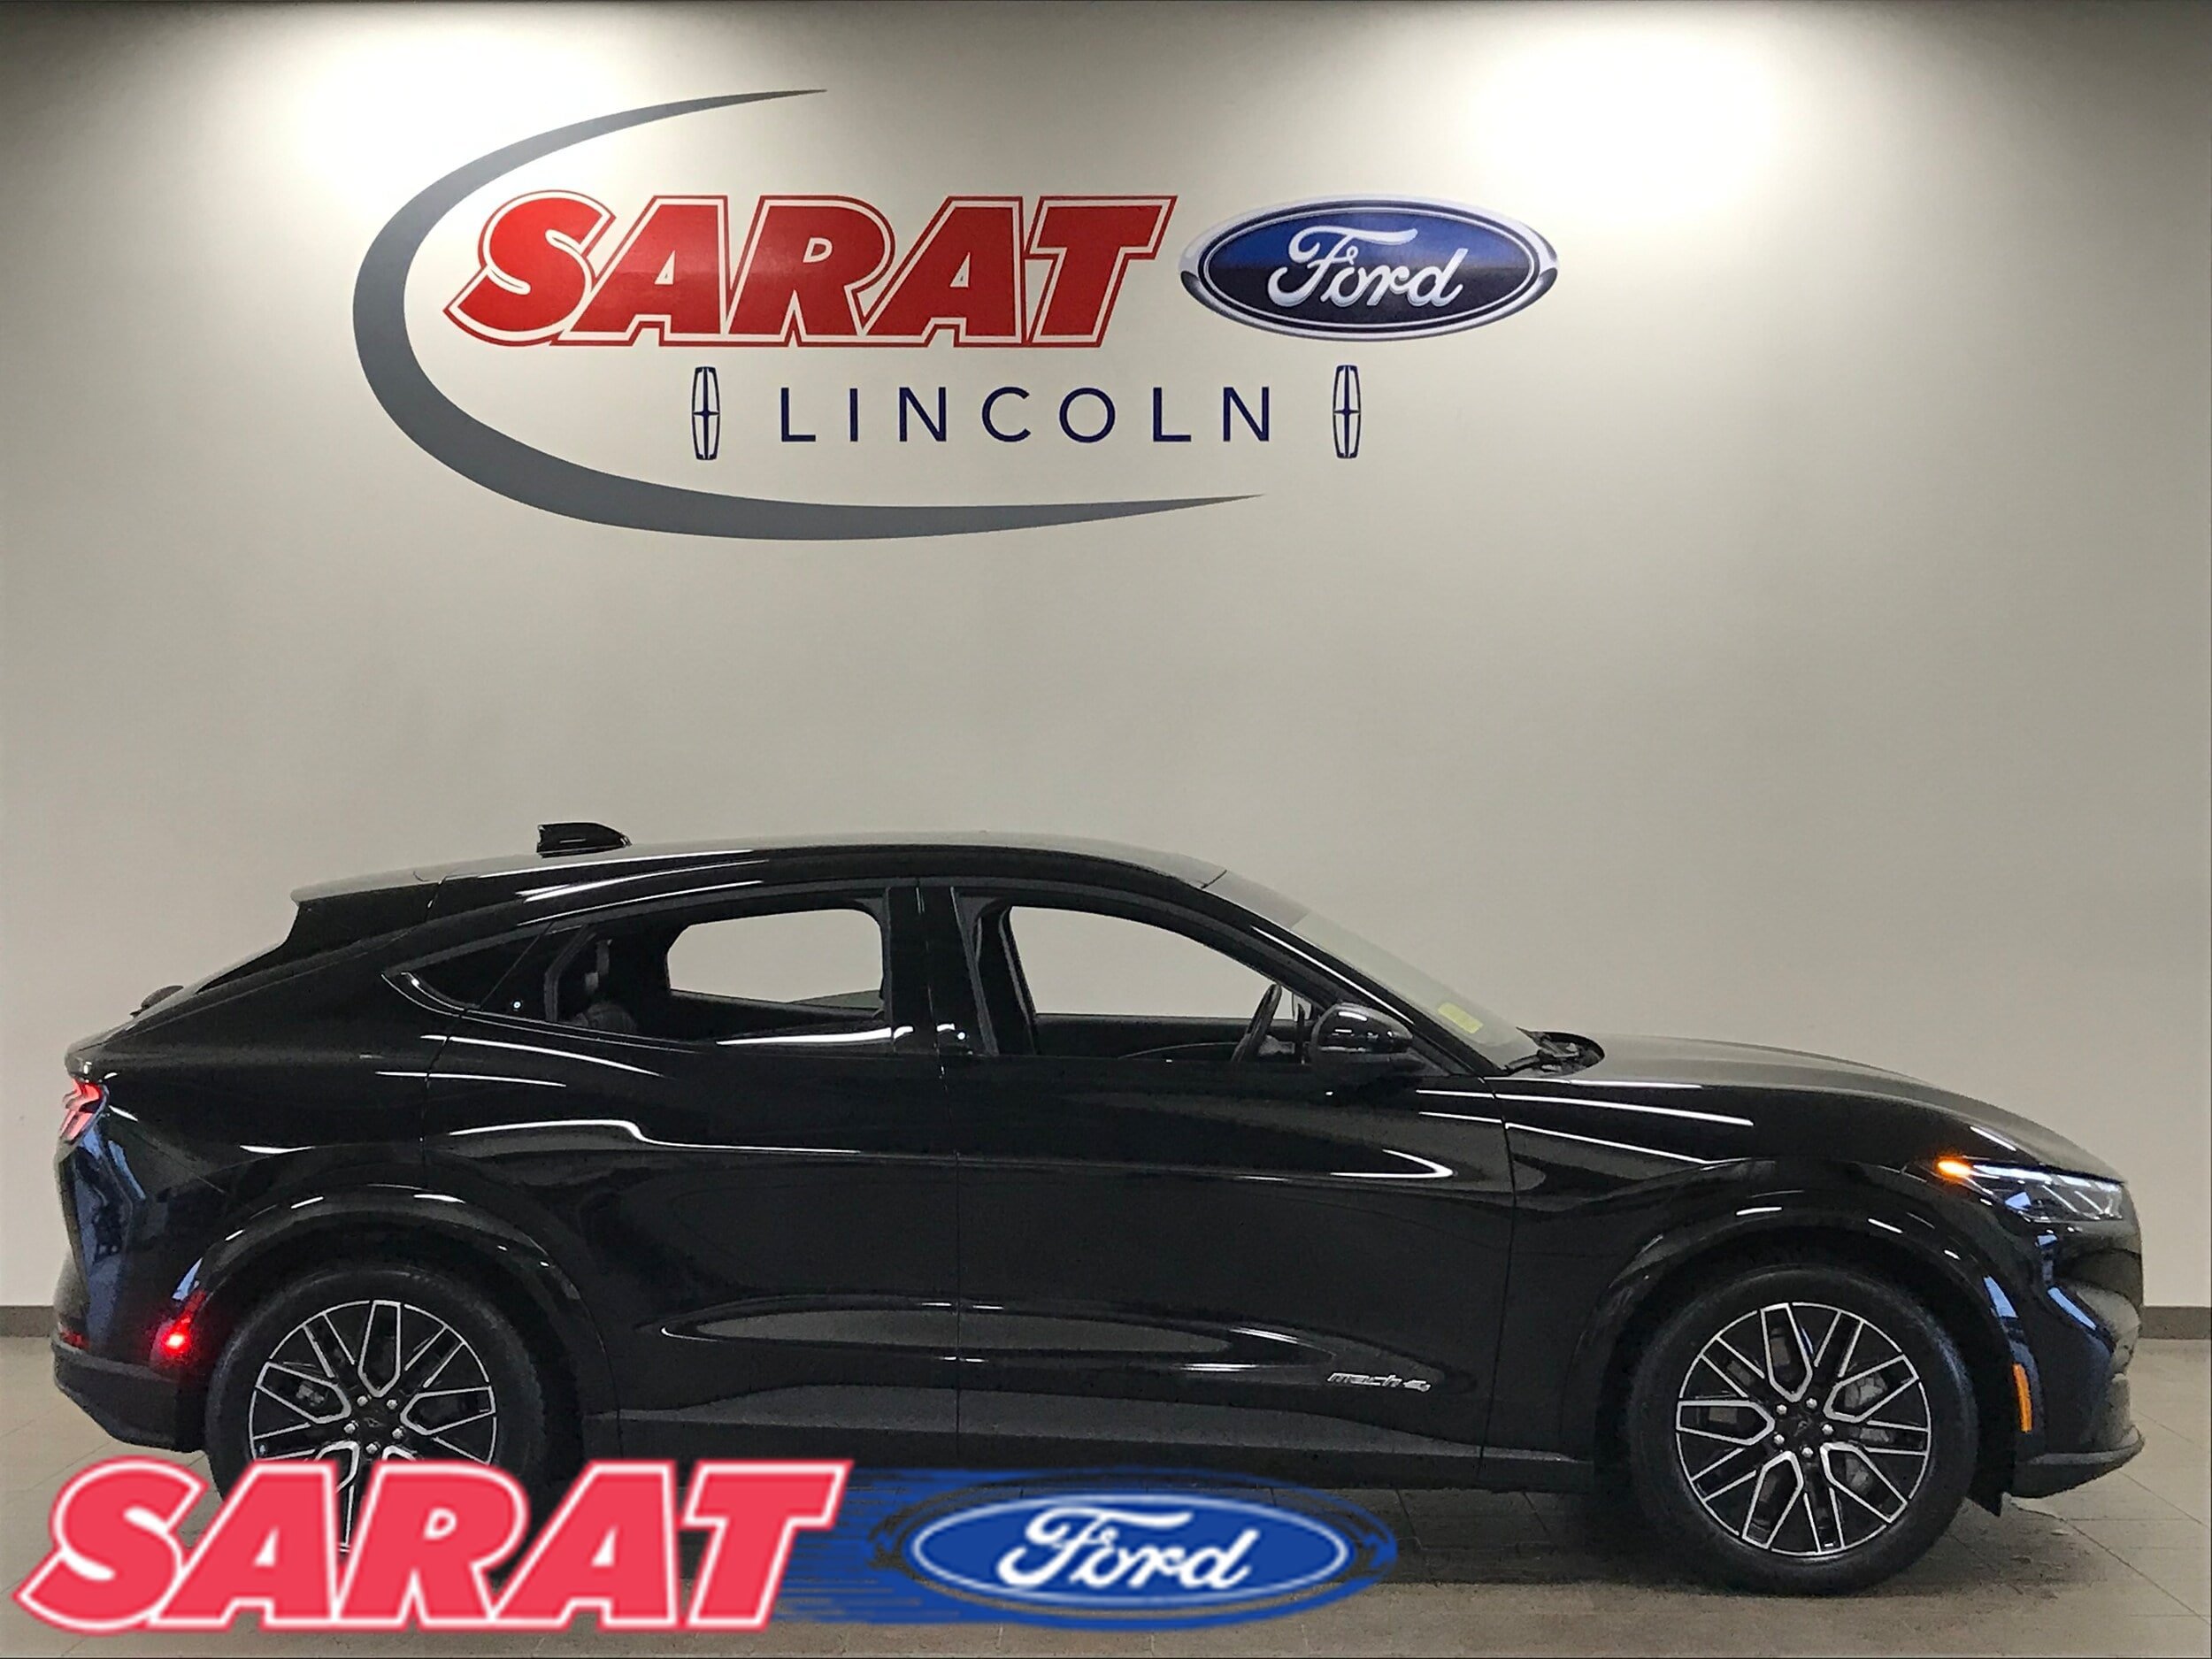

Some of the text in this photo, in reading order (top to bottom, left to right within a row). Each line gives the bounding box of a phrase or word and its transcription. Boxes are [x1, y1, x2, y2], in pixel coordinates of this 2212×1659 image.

[443, 190, 1468, 348] SARAT Ford
[780, 387, 1271, 442] LINCOLN
